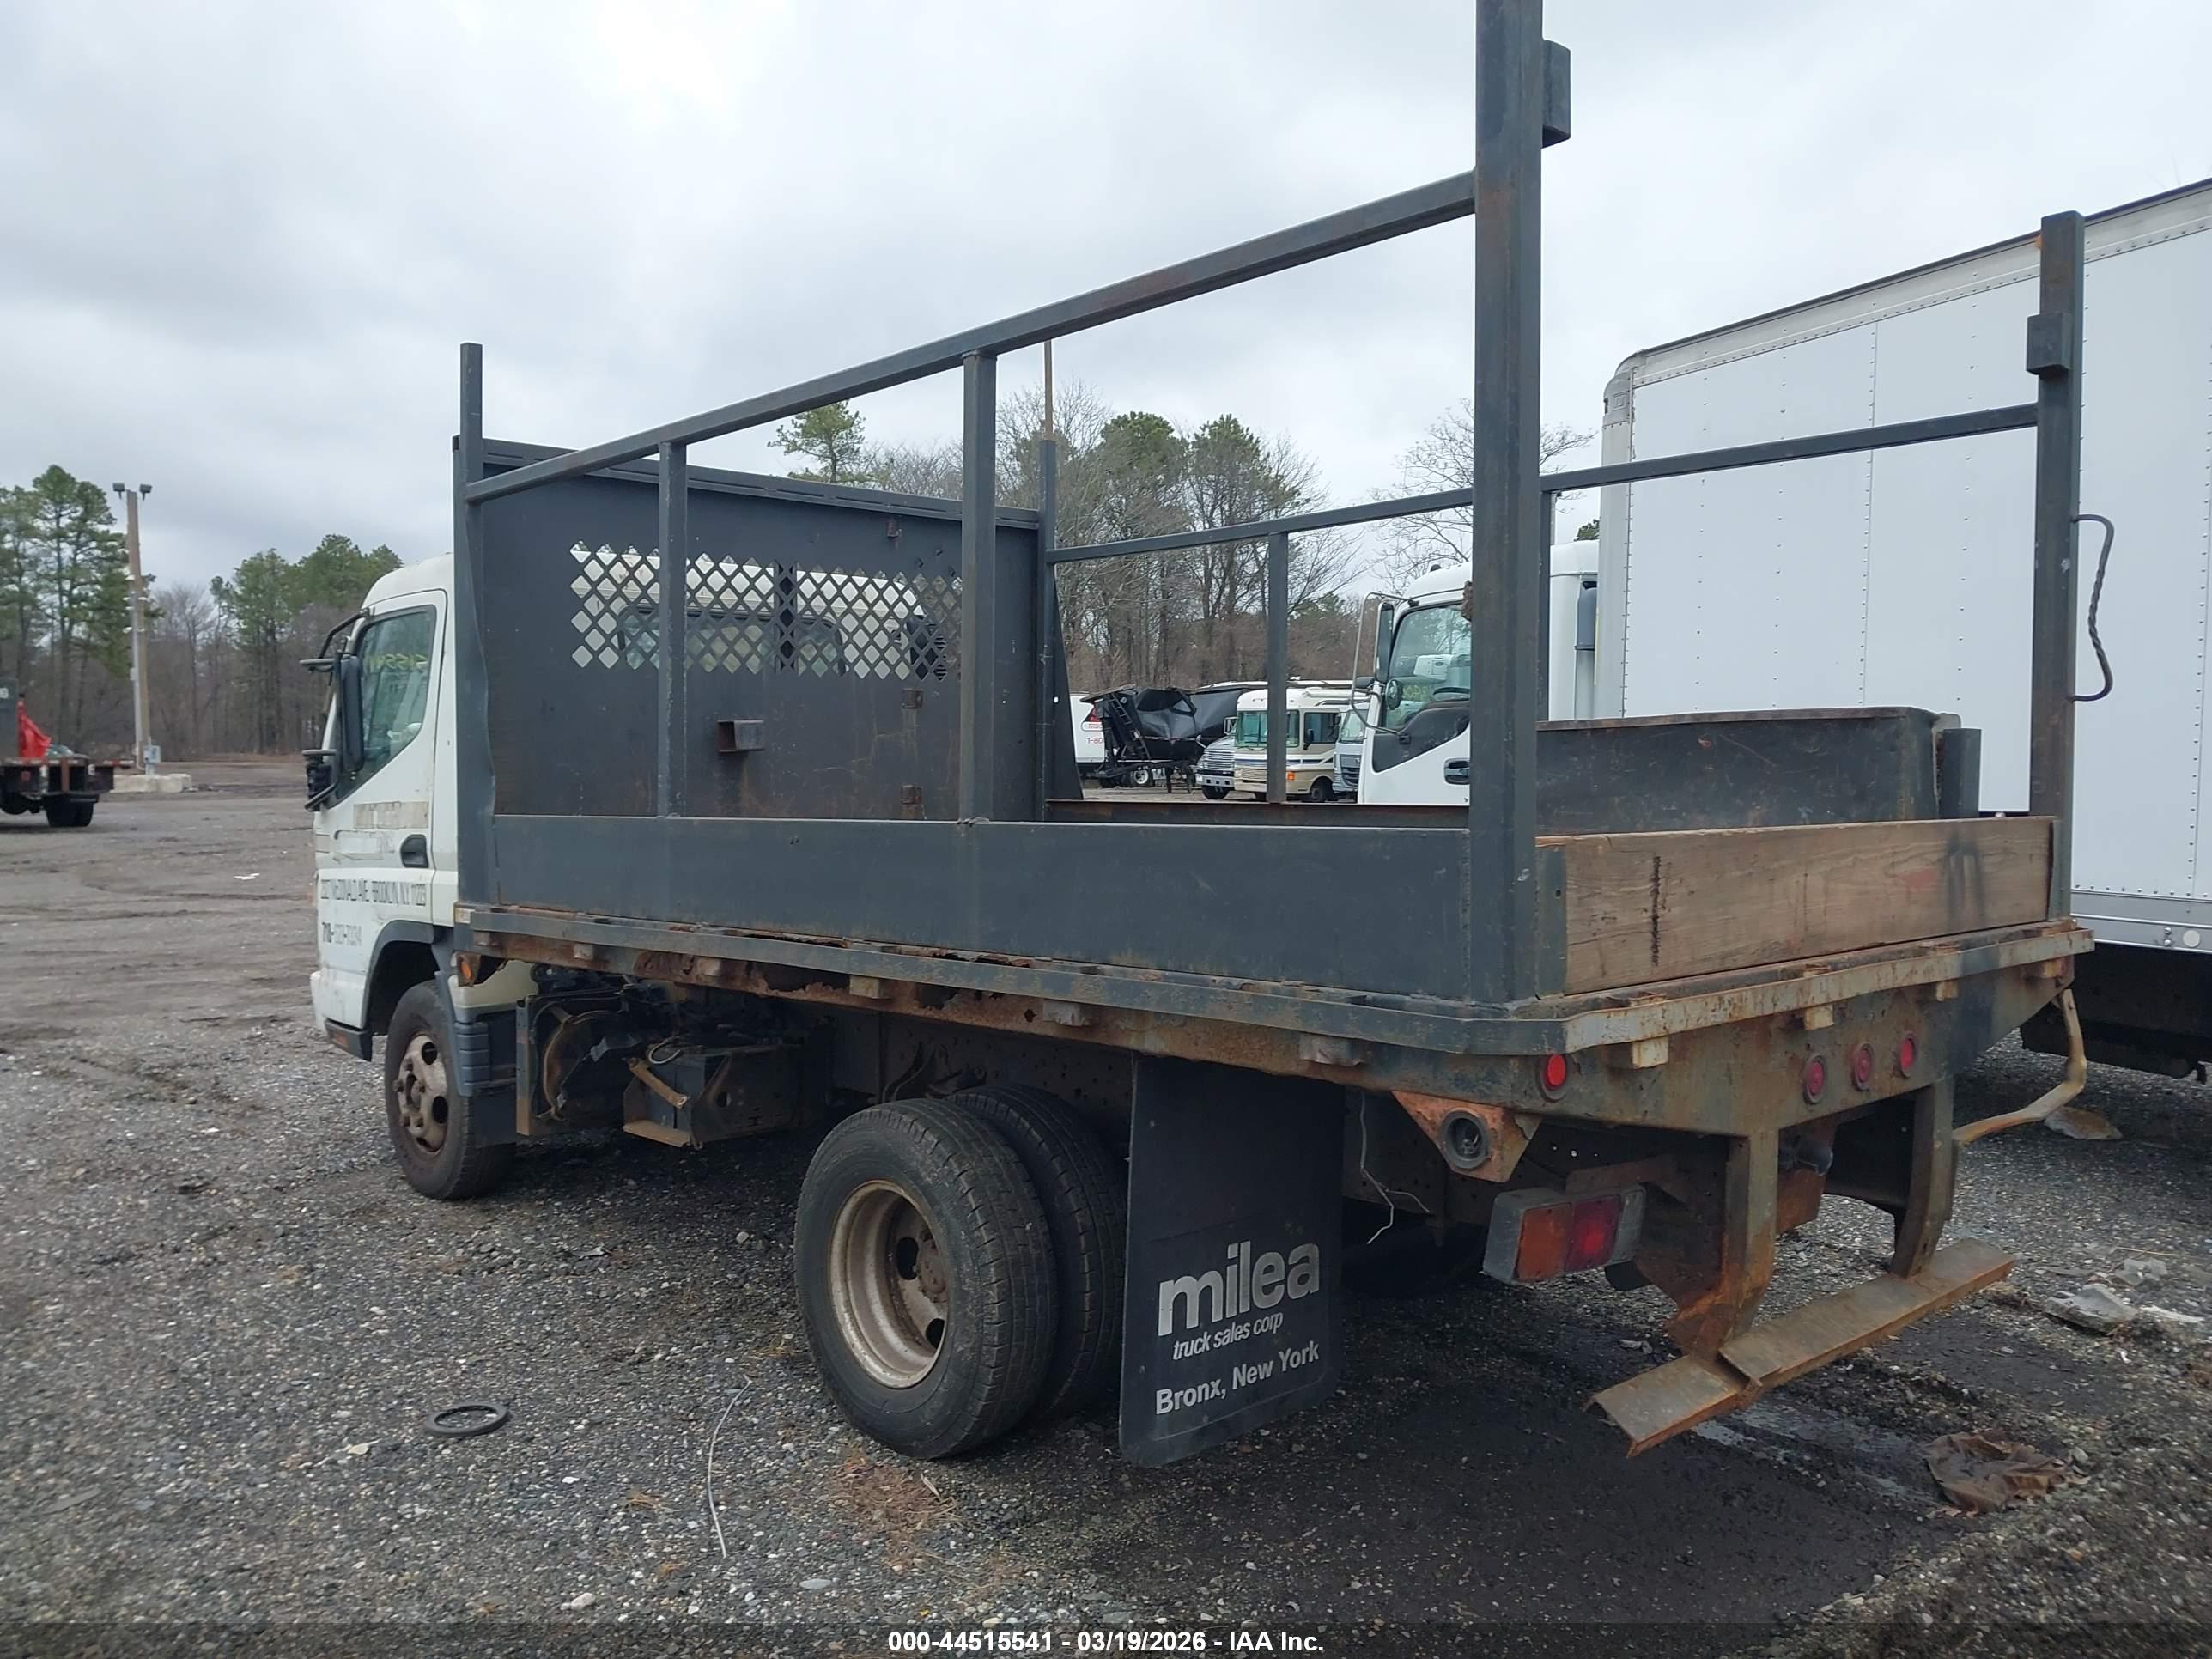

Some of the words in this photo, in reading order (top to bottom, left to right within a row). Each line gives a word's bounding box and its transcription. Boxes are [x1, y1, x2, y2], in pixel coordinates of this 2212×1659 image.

[1158, 1240, 1320, 1336] milea
[1172, 1331, 1211, 1361] truck
[1213, 1321, 1251, 1349] sales
[1253, 1311, 1284, 1334] corp
[1155, 1376, 1227, 1415] Bronx,
[1231, 1359, 1274, 1390] New
[1279, 1340, 1320, 1372] York
